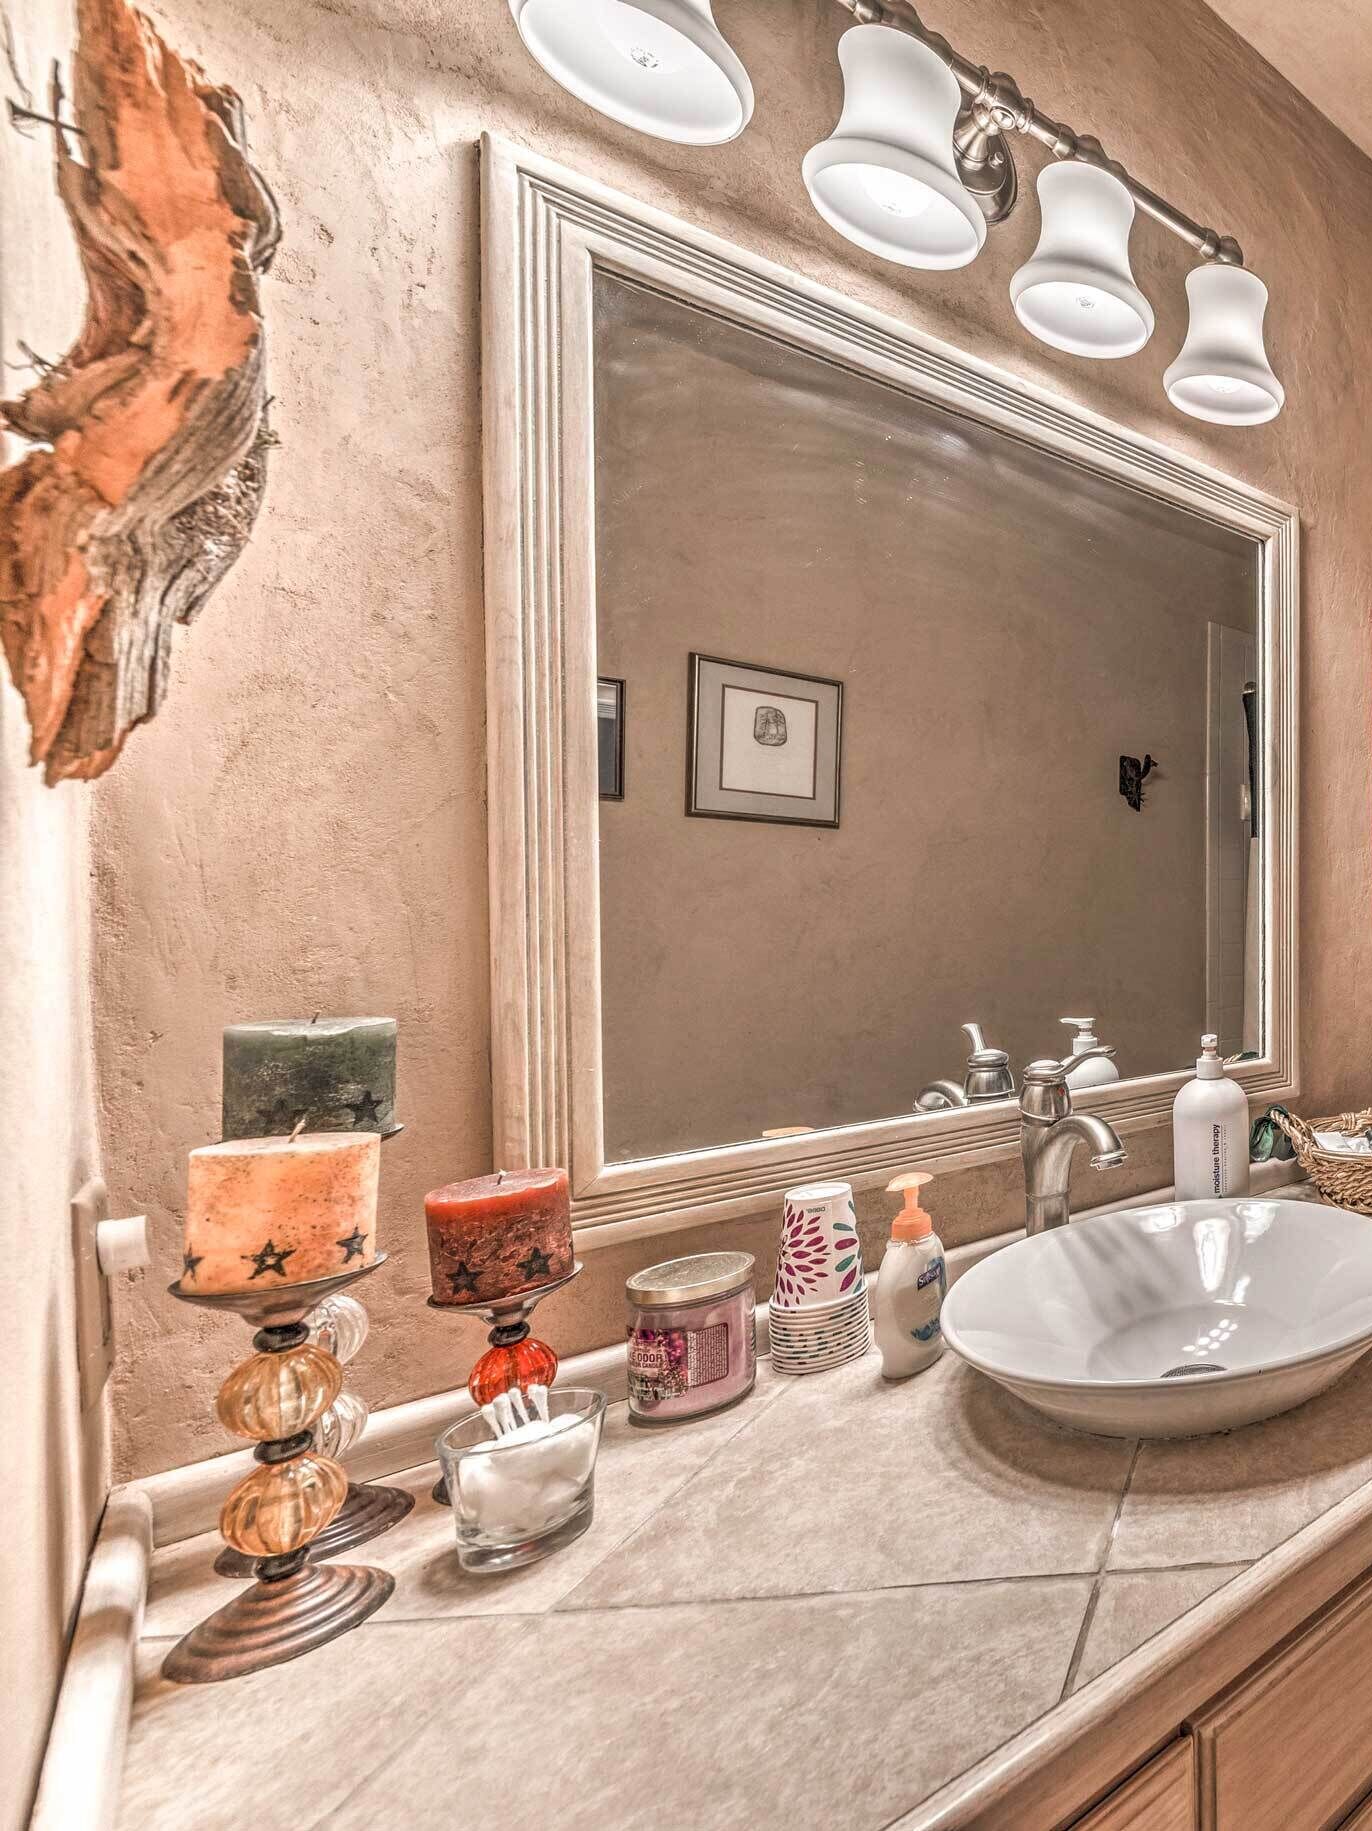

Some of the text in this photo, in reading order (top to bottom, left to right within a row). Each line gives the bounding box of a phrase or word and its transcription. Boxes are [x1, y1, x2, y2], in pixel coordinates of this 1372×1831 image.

[1211, 1124, 1221, 1194] moisture therapy
[637, 1353, 663, 1363] ODOR
